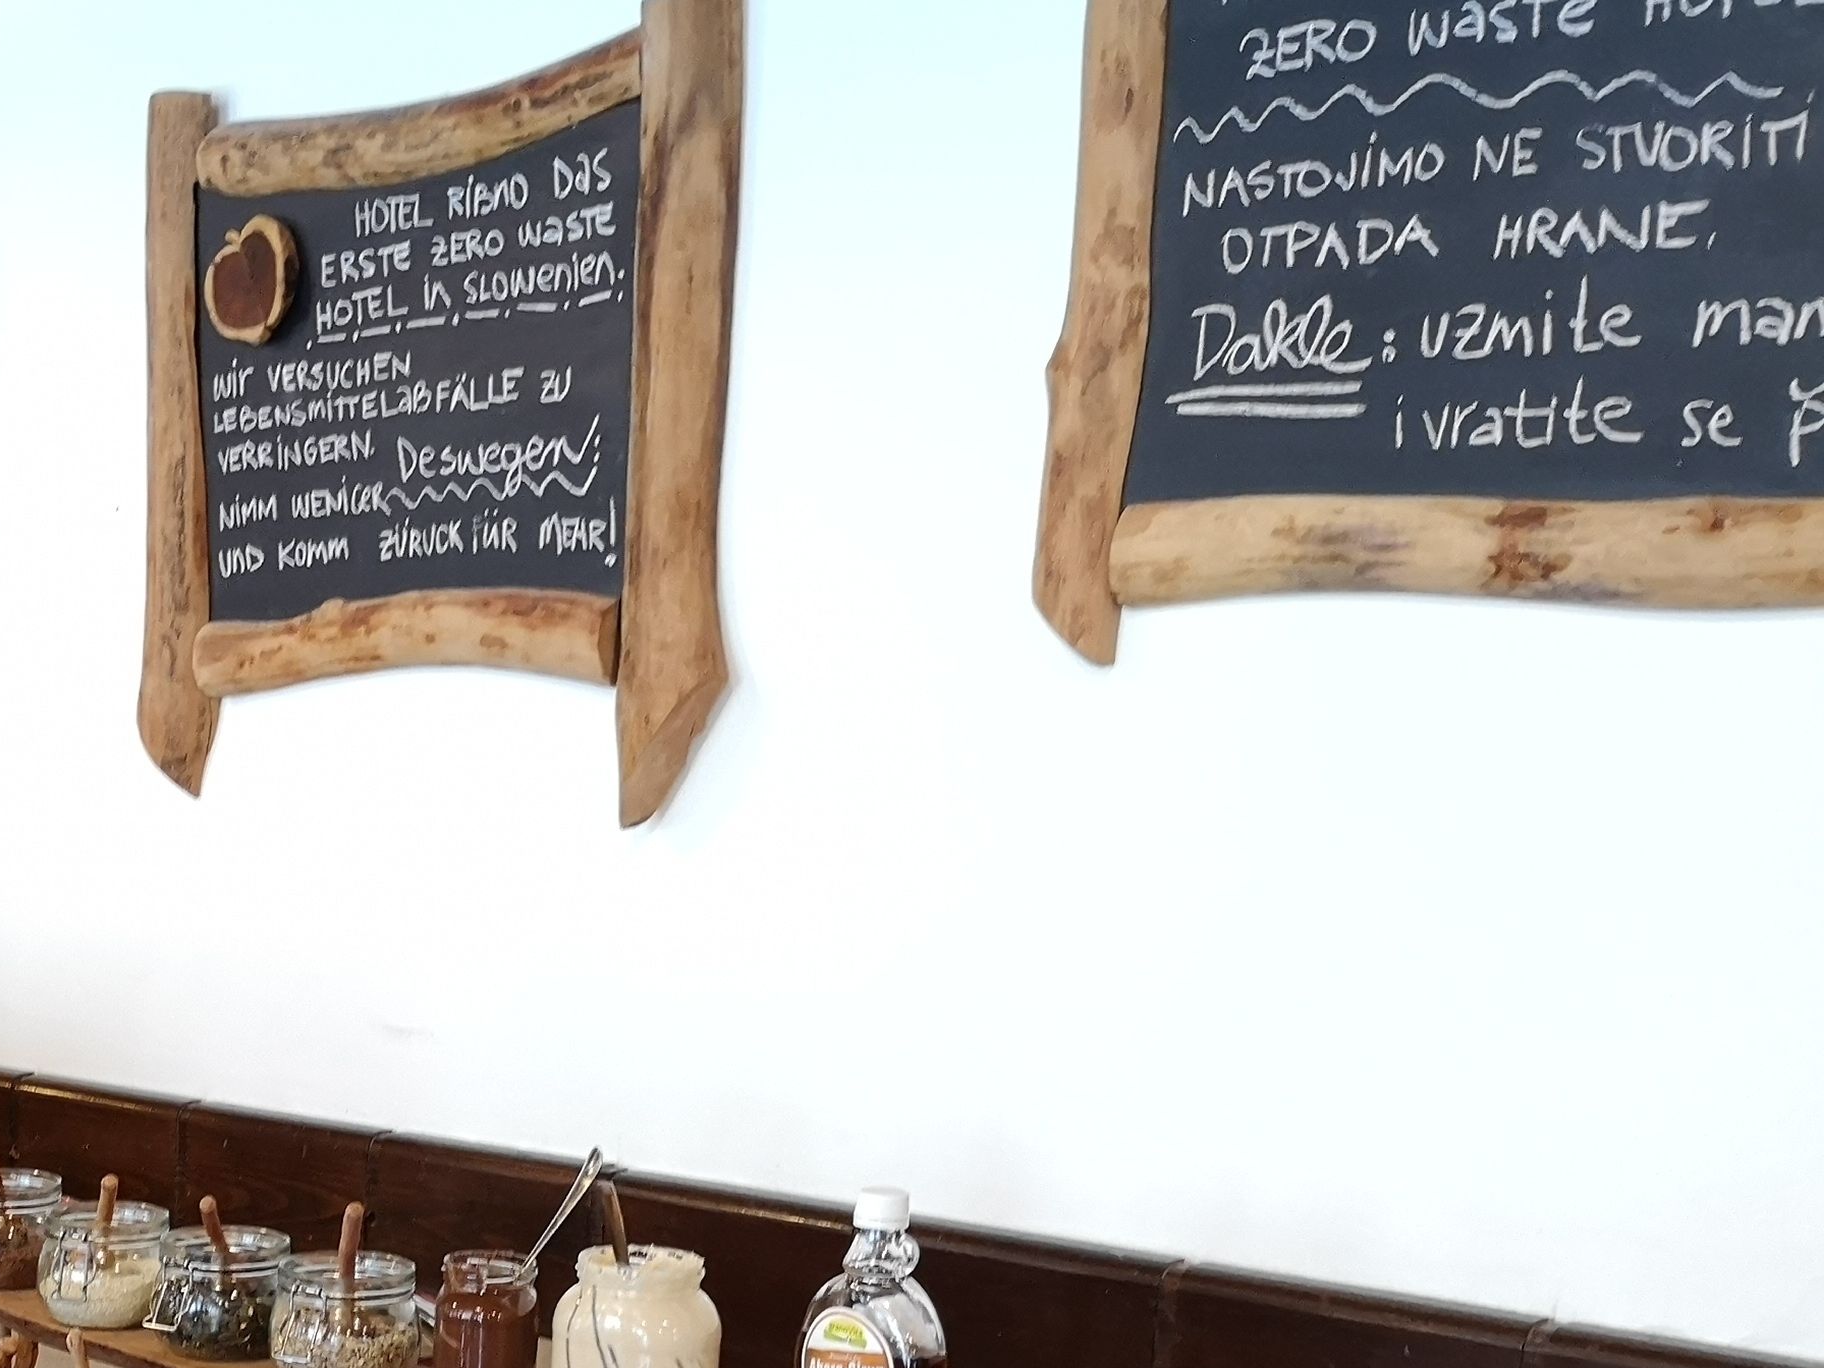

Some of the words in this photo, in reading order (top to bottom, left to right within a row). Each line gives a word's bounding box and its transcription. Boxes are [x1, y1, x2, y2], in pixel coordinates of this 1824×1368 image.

[1239, 19, 1377, 80] ZERO
[1182, 131, 1446, 217] NASTOJIMO
[1473, 127, 1543, 181] NE
[354, 193, 433, 238] HOTEL
[320, 239, 411, 288] ERSTE
[430, 226, 504, 267] ZERO
[1220, 213, 1440, 275] OTPADA
[316, 283, 408, 335] HOTEL
[267, 350, 412, 394] VERSUCHEN
[539, 366, 572, 404] ZU
[1681, 398, 1744, 447] se
[472, 498, 518, 555] FÜR
[538, 495, 618, 569] MEHR!
